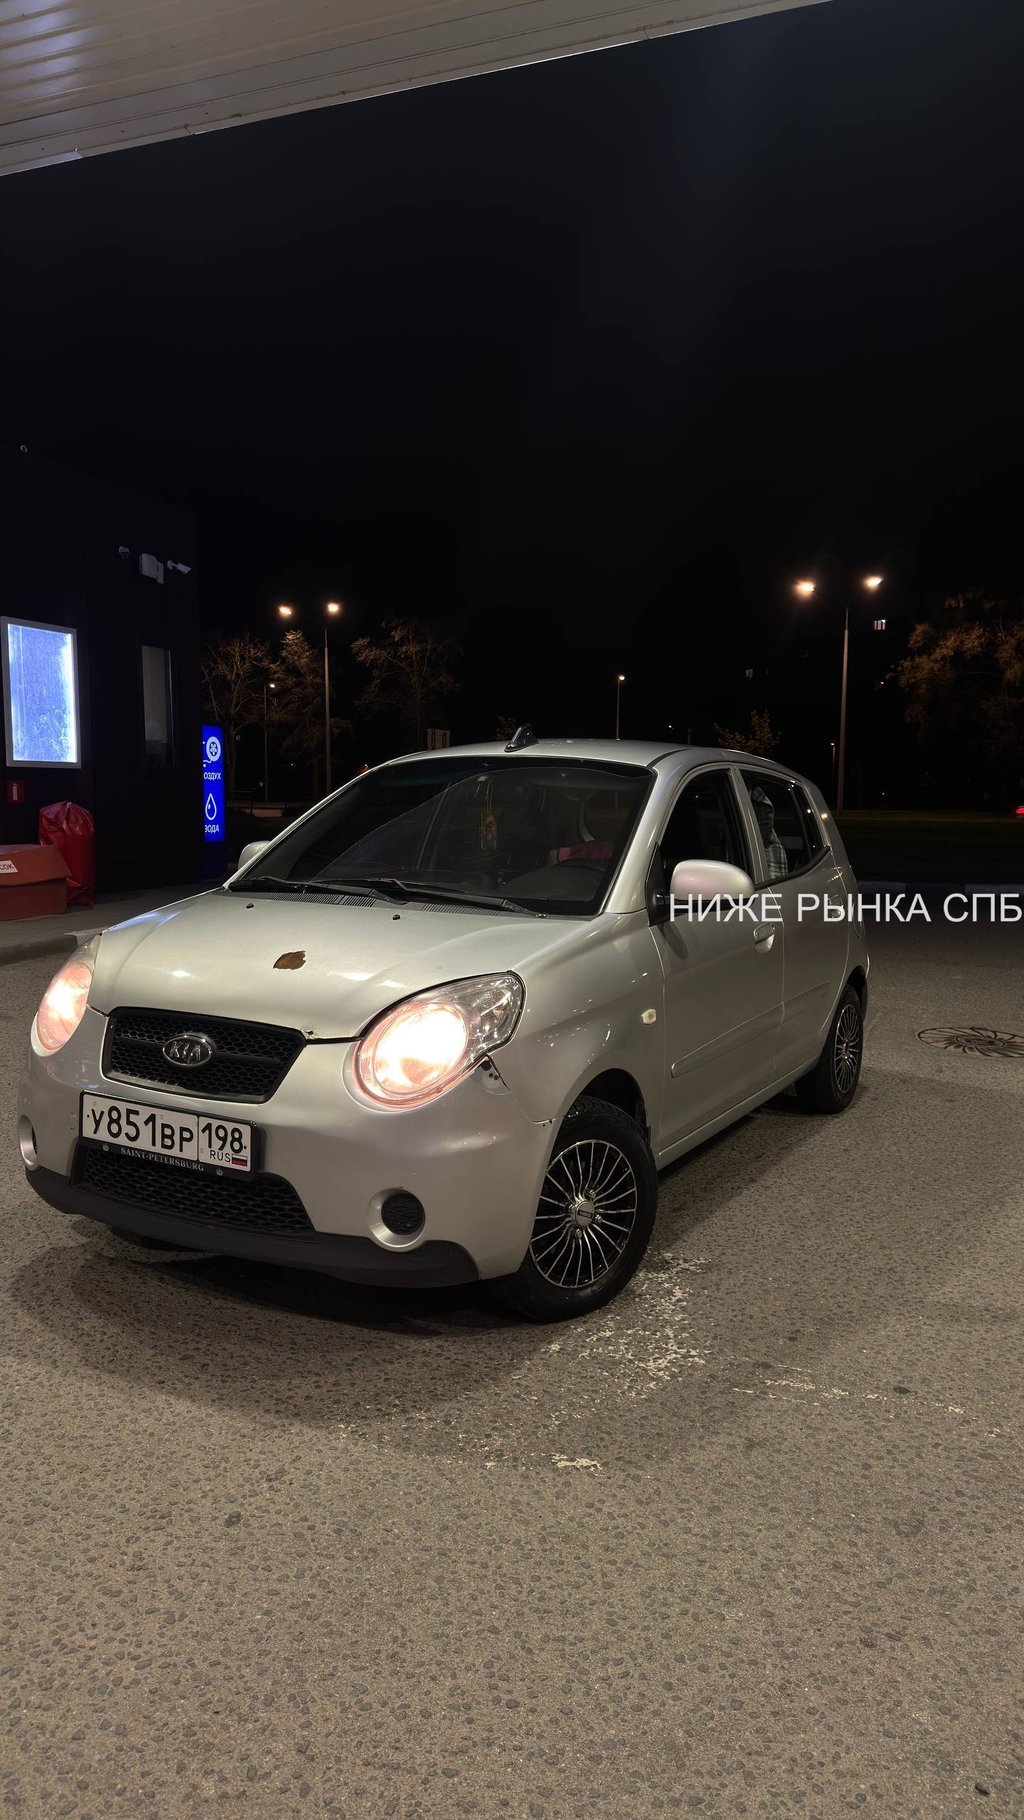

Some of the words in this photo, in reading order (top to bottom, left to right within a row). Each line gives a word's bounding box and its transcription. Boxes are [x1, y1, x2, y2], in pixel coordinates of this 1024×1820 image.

[203, 771, 221, 781] ОЗДУХ
[91, 1105, 194, 1153] У851ВР
[201, 1122, 243, 1154] 198
[120, 1147, 205, 1172] SAINT-PETERSBURG
[209, 1149, 231, 1163] RUS
